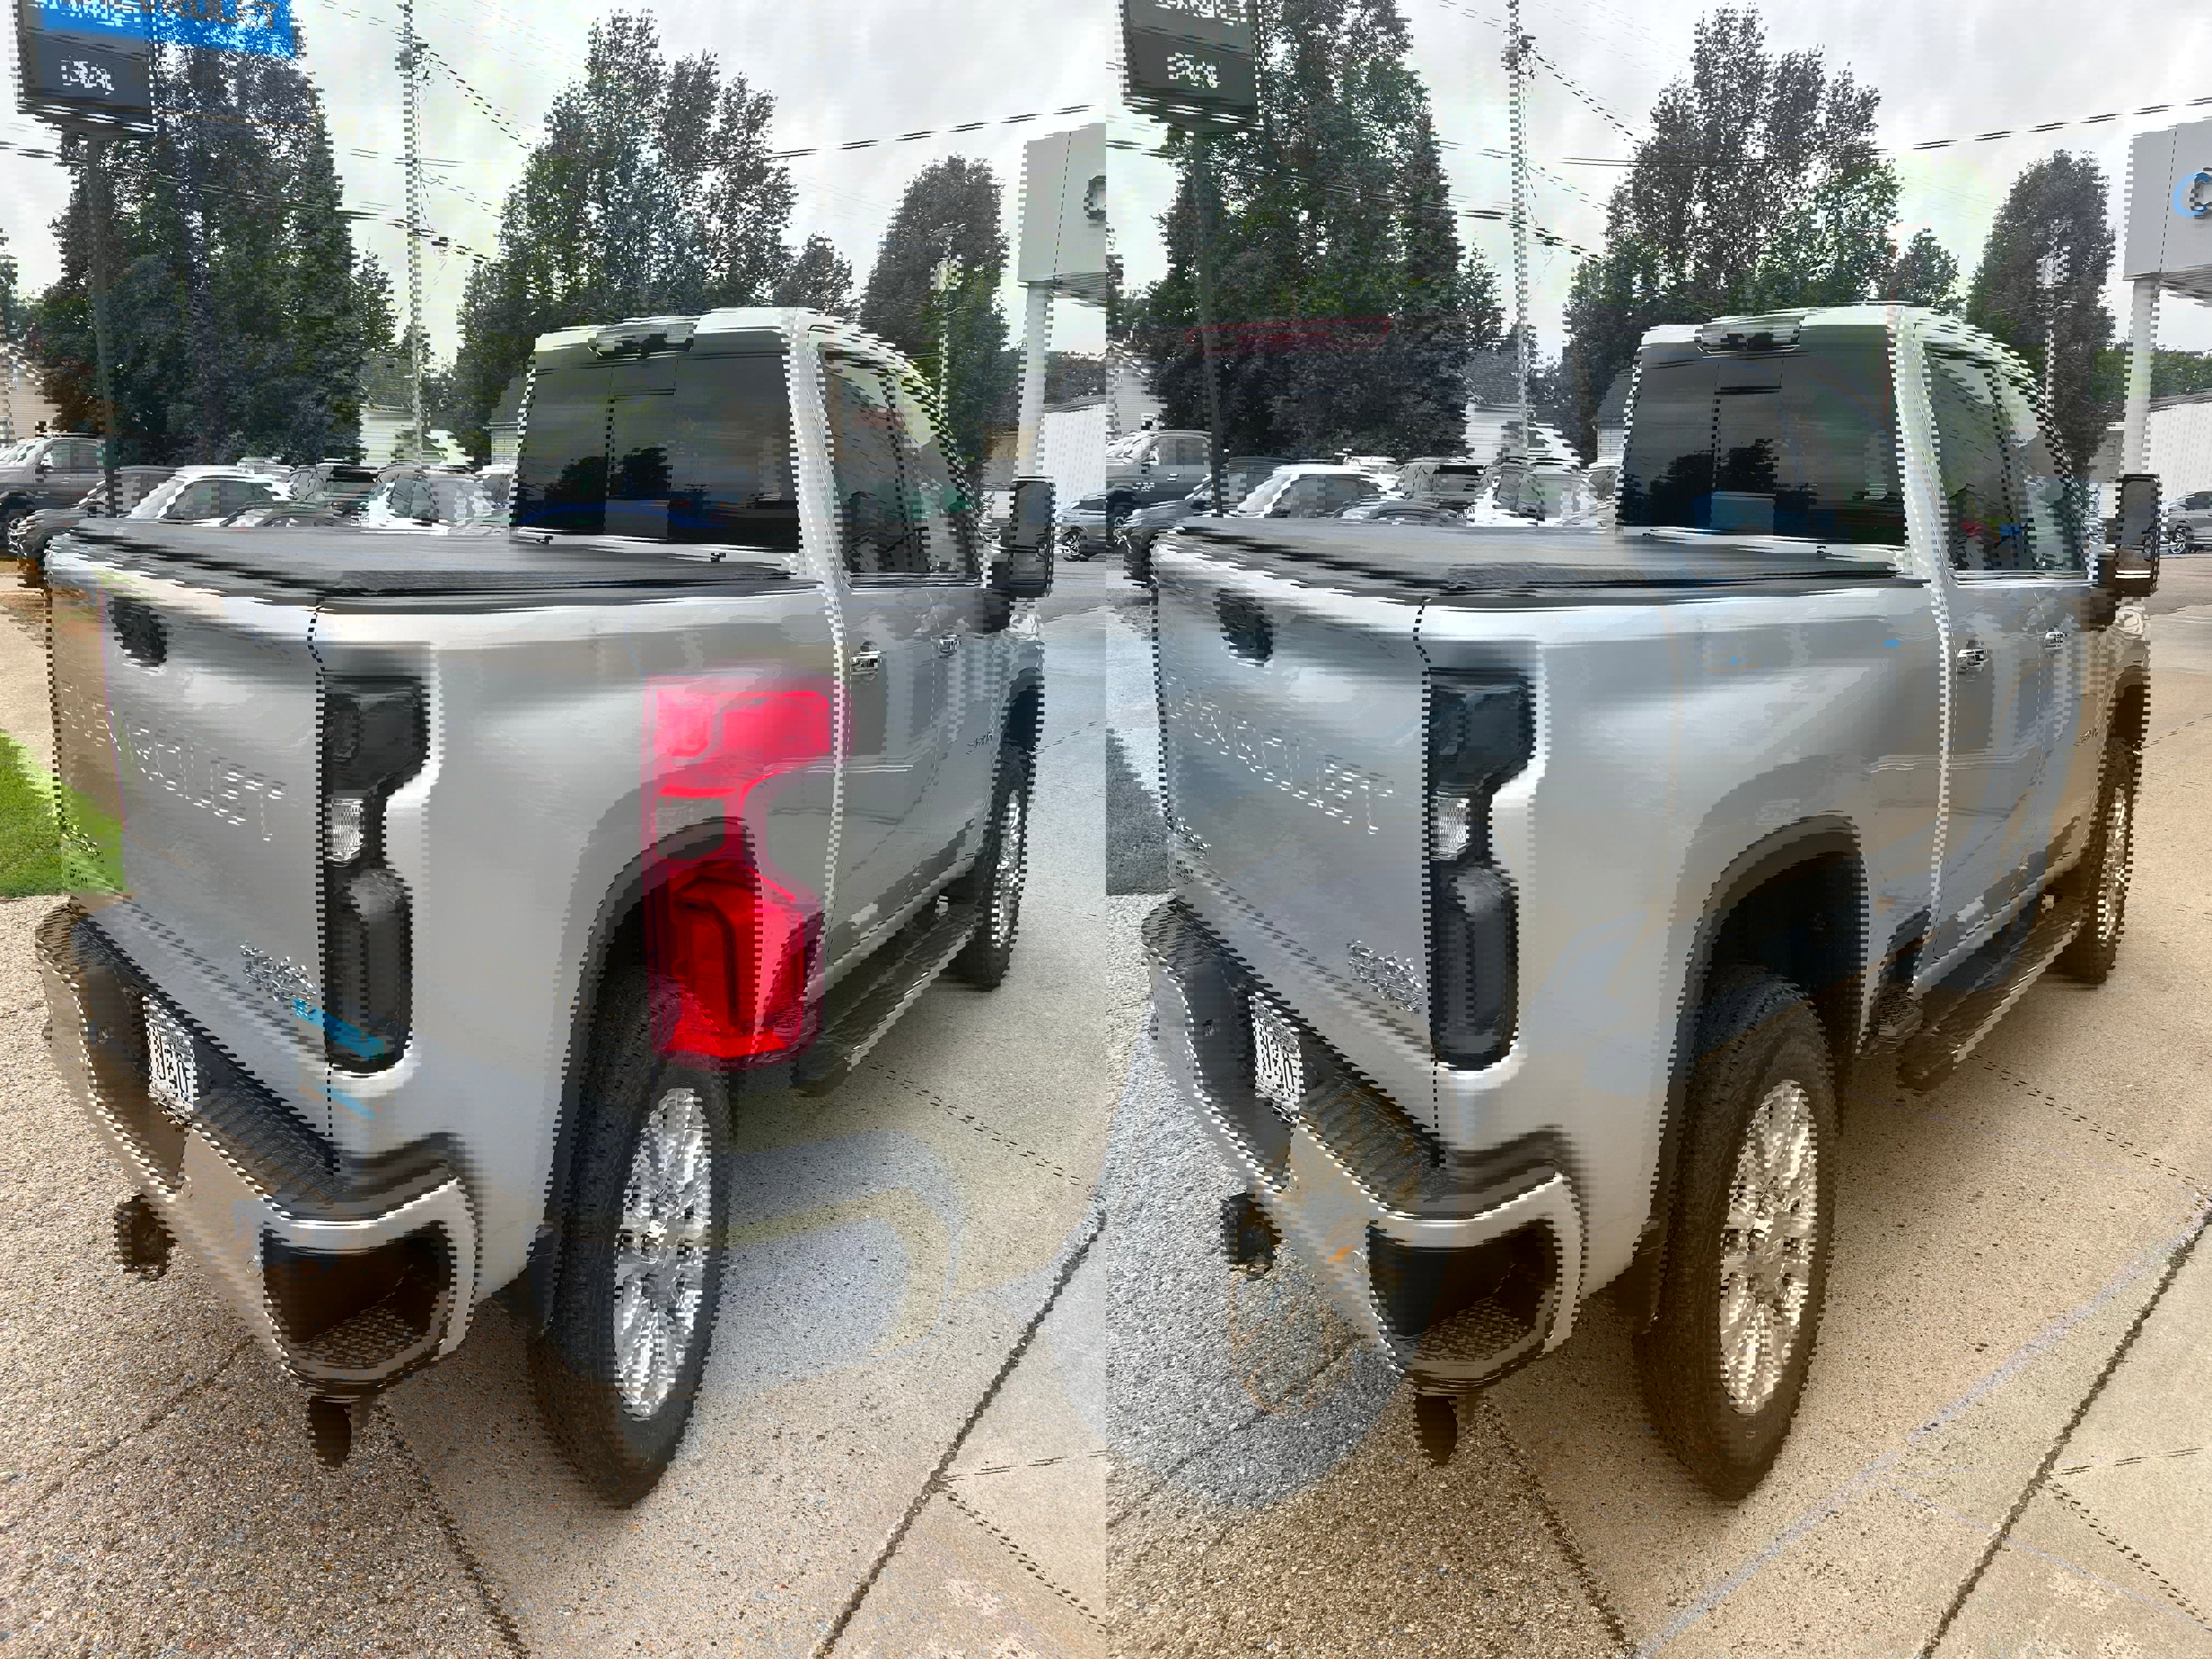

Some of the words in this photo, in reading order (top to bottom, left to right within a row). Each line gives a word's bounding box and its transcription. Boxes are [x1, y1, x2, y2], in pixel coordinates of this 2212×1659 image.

[130, 55, 227, 91] BRAU
[121, 672, 569, 837] CHEVROLET
[140, 861, 171, 885] BRAU
[488, 960, 628, 1020] COUNTRY
[301, 1022, 373, 1102] YNJ2500
[306, 1070, 316, 1086] FEB
[325, 1085, 369, 1116] Noncommercial
